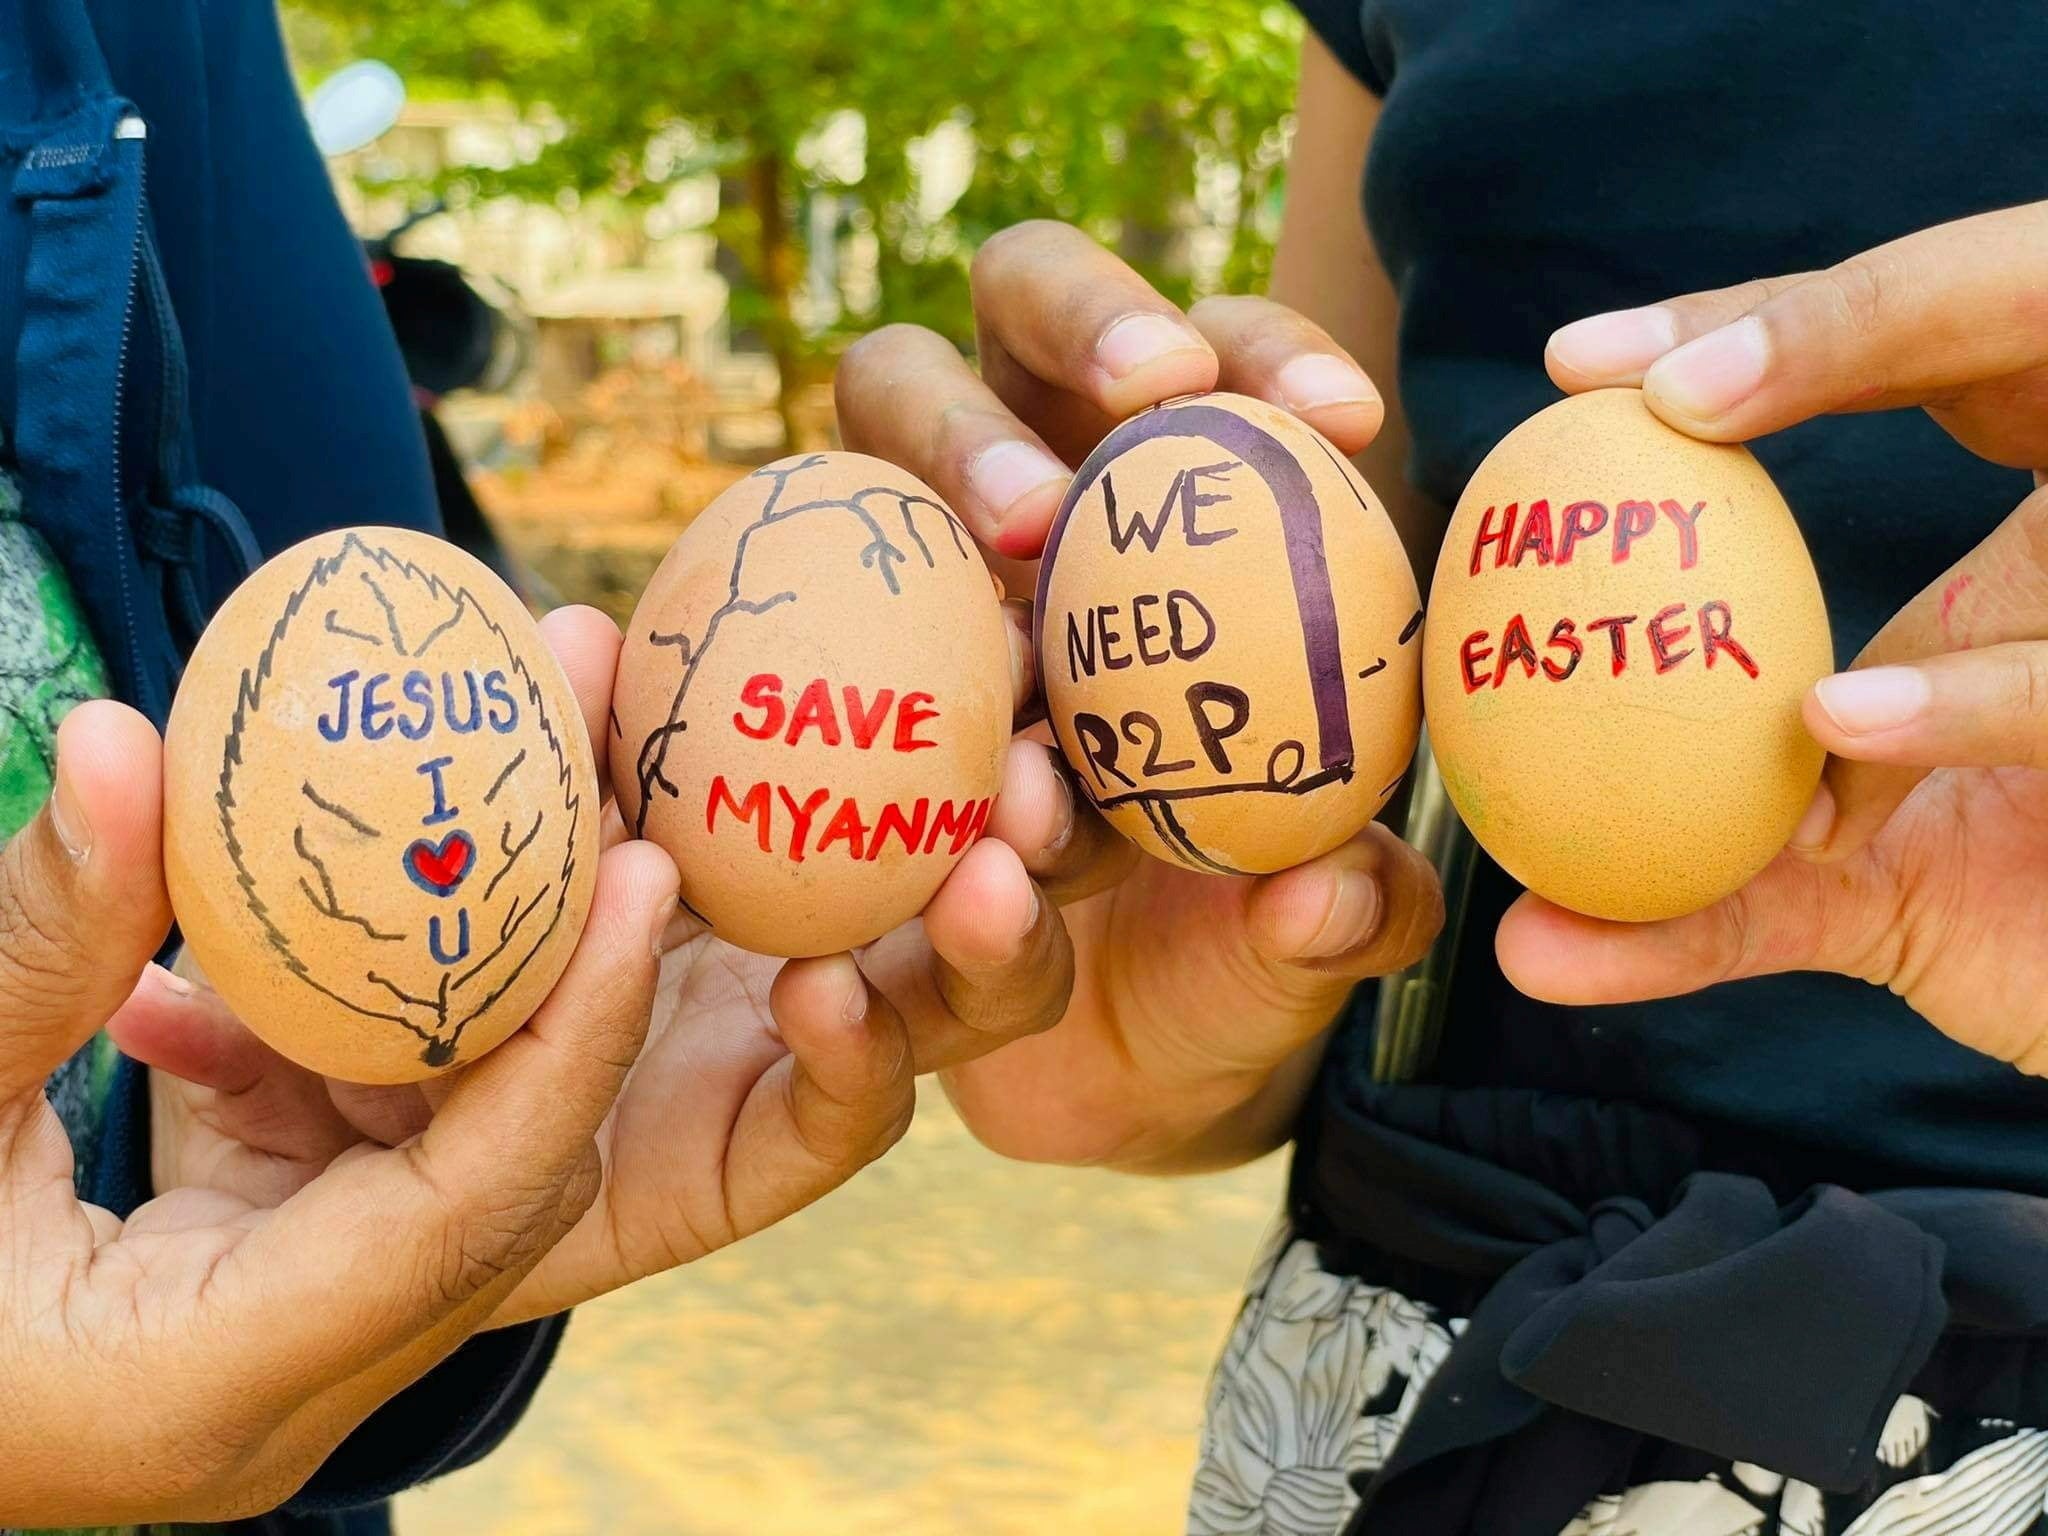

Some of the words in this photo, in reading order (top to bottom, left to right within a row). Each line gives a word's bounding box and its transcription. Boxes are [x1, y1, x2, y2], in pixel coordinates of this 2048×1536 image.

[1101, 461, 1243, 553] WE
[1470, 499, 1706, 577] HAPPY
[1067, 589, 1216, 682] NEED
[1460, 600, 1759, 694] EASTER
[317, 669, 520, 741] JESUS
[733, 673, 941, 752] SAVE
[1074, 681, 1250, 788] R2P
[417, 756, 459, 825] I
[429, 908, 470, 965] U
